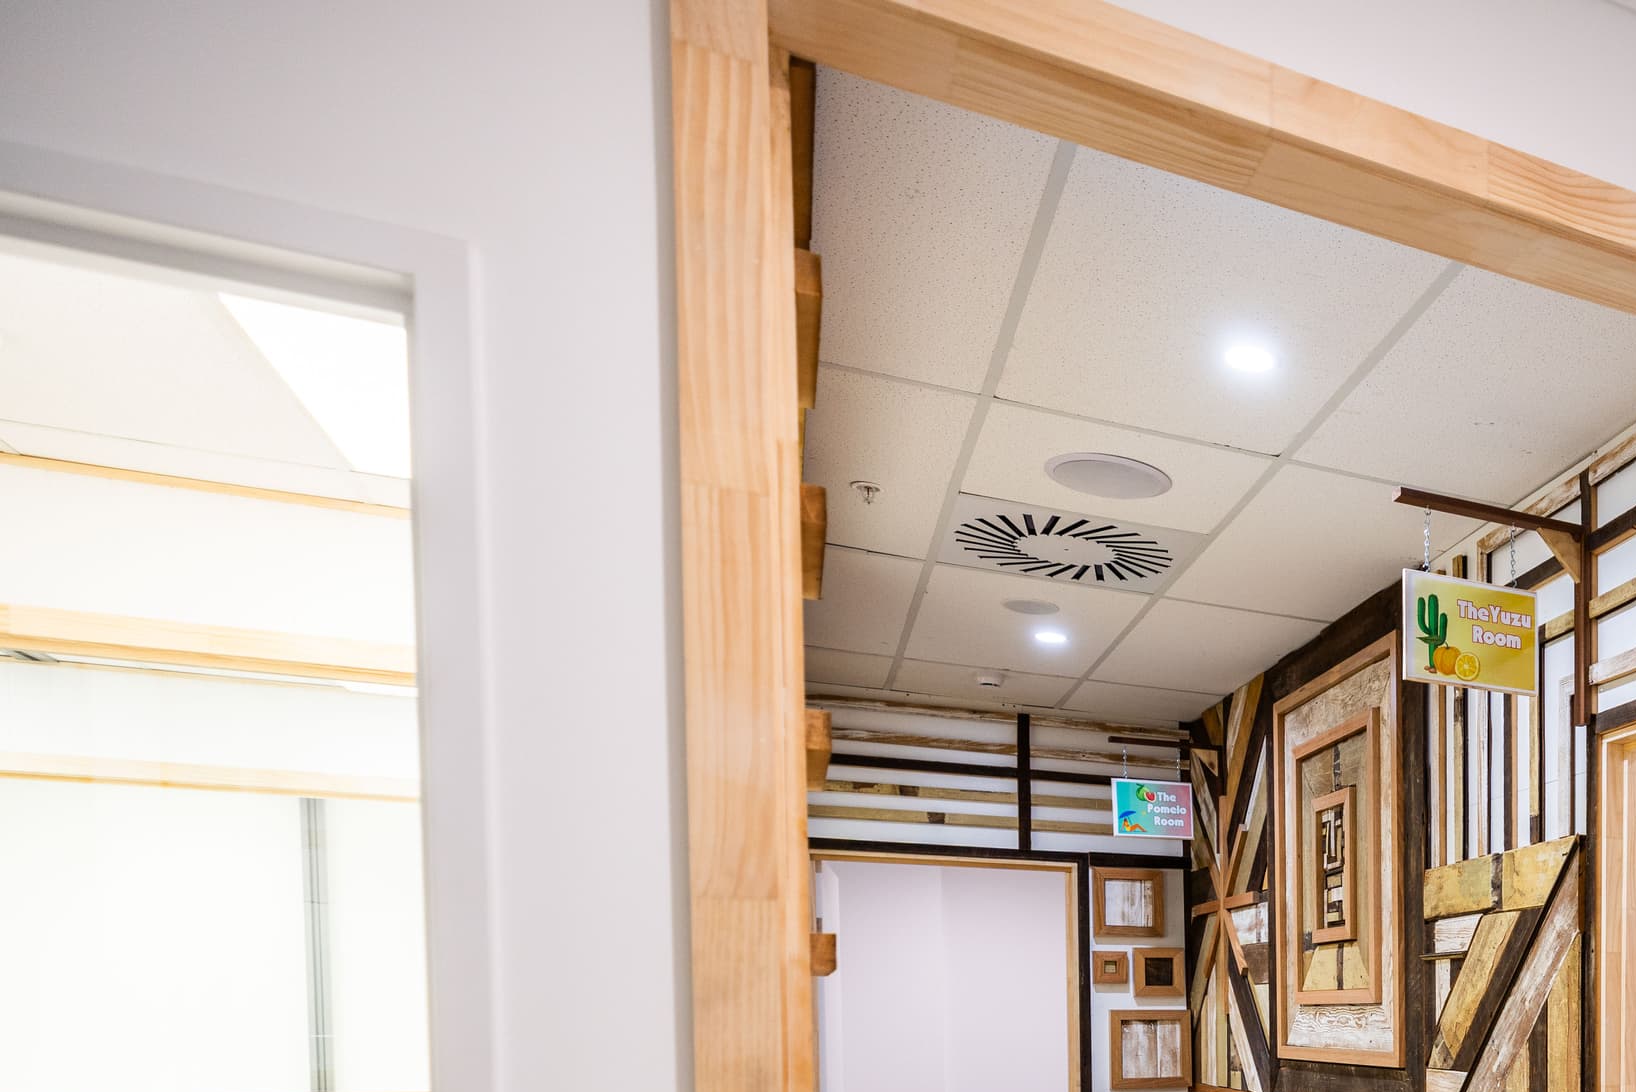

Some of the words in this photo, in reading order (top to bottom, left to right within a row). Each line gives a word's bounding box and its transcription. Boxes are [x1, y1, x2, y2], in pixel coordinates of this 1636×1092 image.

[1472, 625, 1521, 649] Room
[1157, 791, 1176, 802] The
[1147, 803, 1187, 814] Pomelo
[1154, 816, 1184, 827] Room
